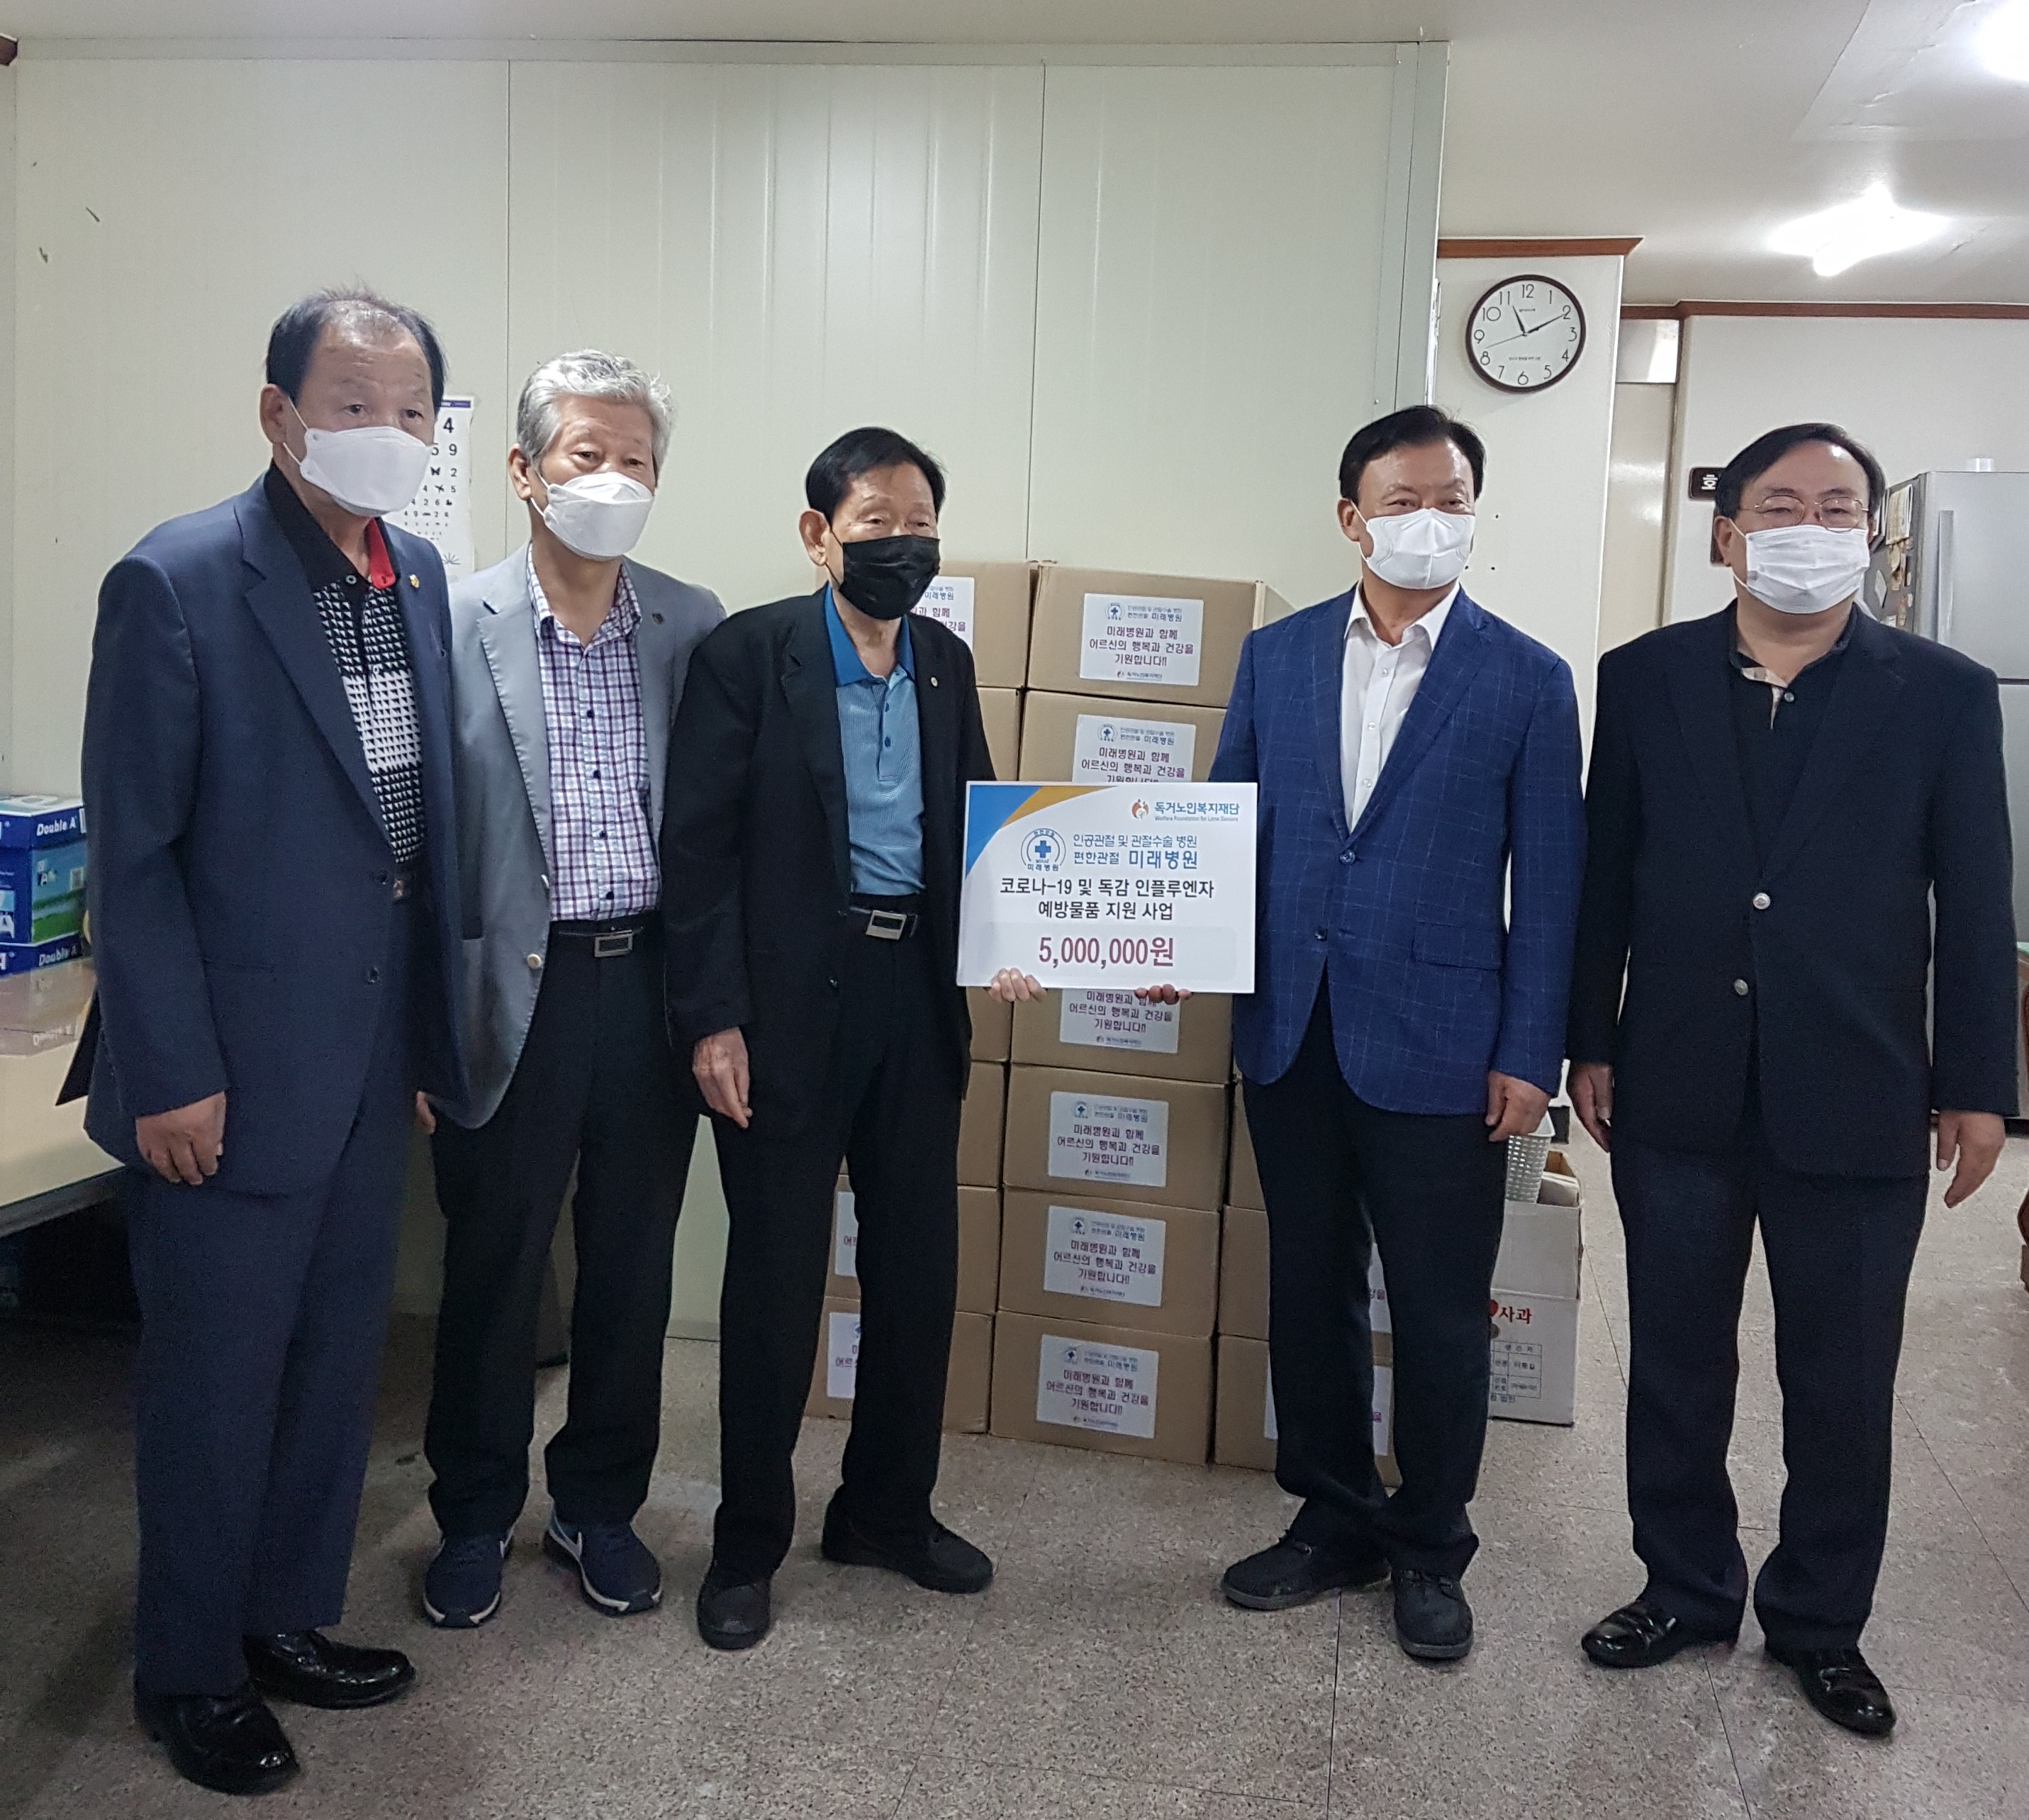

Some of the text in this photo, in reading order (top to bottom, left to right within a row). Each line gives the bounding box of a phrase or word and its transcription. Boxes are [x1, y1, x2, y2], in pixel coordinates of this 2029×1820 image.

[1499, 291, 1511, 306] 11
[1521, 284, 1535, 298] 12
[1482, 306, 1501, 321] 10
[1563, 305, 1571, 320] 2
[1473, 329, 1485, 344] 9
[1568, 327, 1577, 342] 3
[1480, 351, 1490, 365] 8
[1561, 348, 1570, 362] 4
[1498, 366, 1505, 379] 7
[1517, 371, 1529, 385] 6
[1543, 364, 1552, 379] 5
[442, 417, 454, 433] 4
[449, 443, 457, 456] 9
[450, 468, 457, 477] 2
[1151, 613, 1183, 623] 미래병원
[1107, 626, 1178, 640] 미래병원과 함께
[1090, 638, 1194, 654] 어르신의 행복과 건강을
[1099, 747, 1170, 763] 미래병원과 함께
[1081, 759, 1185, 778] 어르신의 행복과 건강을
[1155, 802, 1240, 815] 독거노인복지재단
[37, 817, 77, 836] Double A
[1073, 834, 1197, 848] 인공관절 및 관절수술 병원
[1074, 850, 1198, 870] 편한관절 미래병원
[1000, 878, 1214, 898] 코로나-19 및 독감 인플루엔자
[1039, 900, 1173, 920] 예방물품 지원 사업
[1039, 937, 1173, 968] 5,000,000원
[1086, 991, 1132, 1005] 미래병원과
[1070, 1003, 1106, 1015] 어르신의
[1145, 1010, 1173, 1022] 건강을
[1074, 1124, 1120, 1139] 미래병원과
[1057, 1137, 1093, 1149] 어르신의
[1133, 1143, 1160, 1156] 건강을
[1071, 1240, 1117, 1256] 미래병원과
[1053, 1251, 1090, 1266] 어르신의
[1129, 1261, 1156, 1275] 건강을
[1499, 1306, 1532, 1324] 사과
